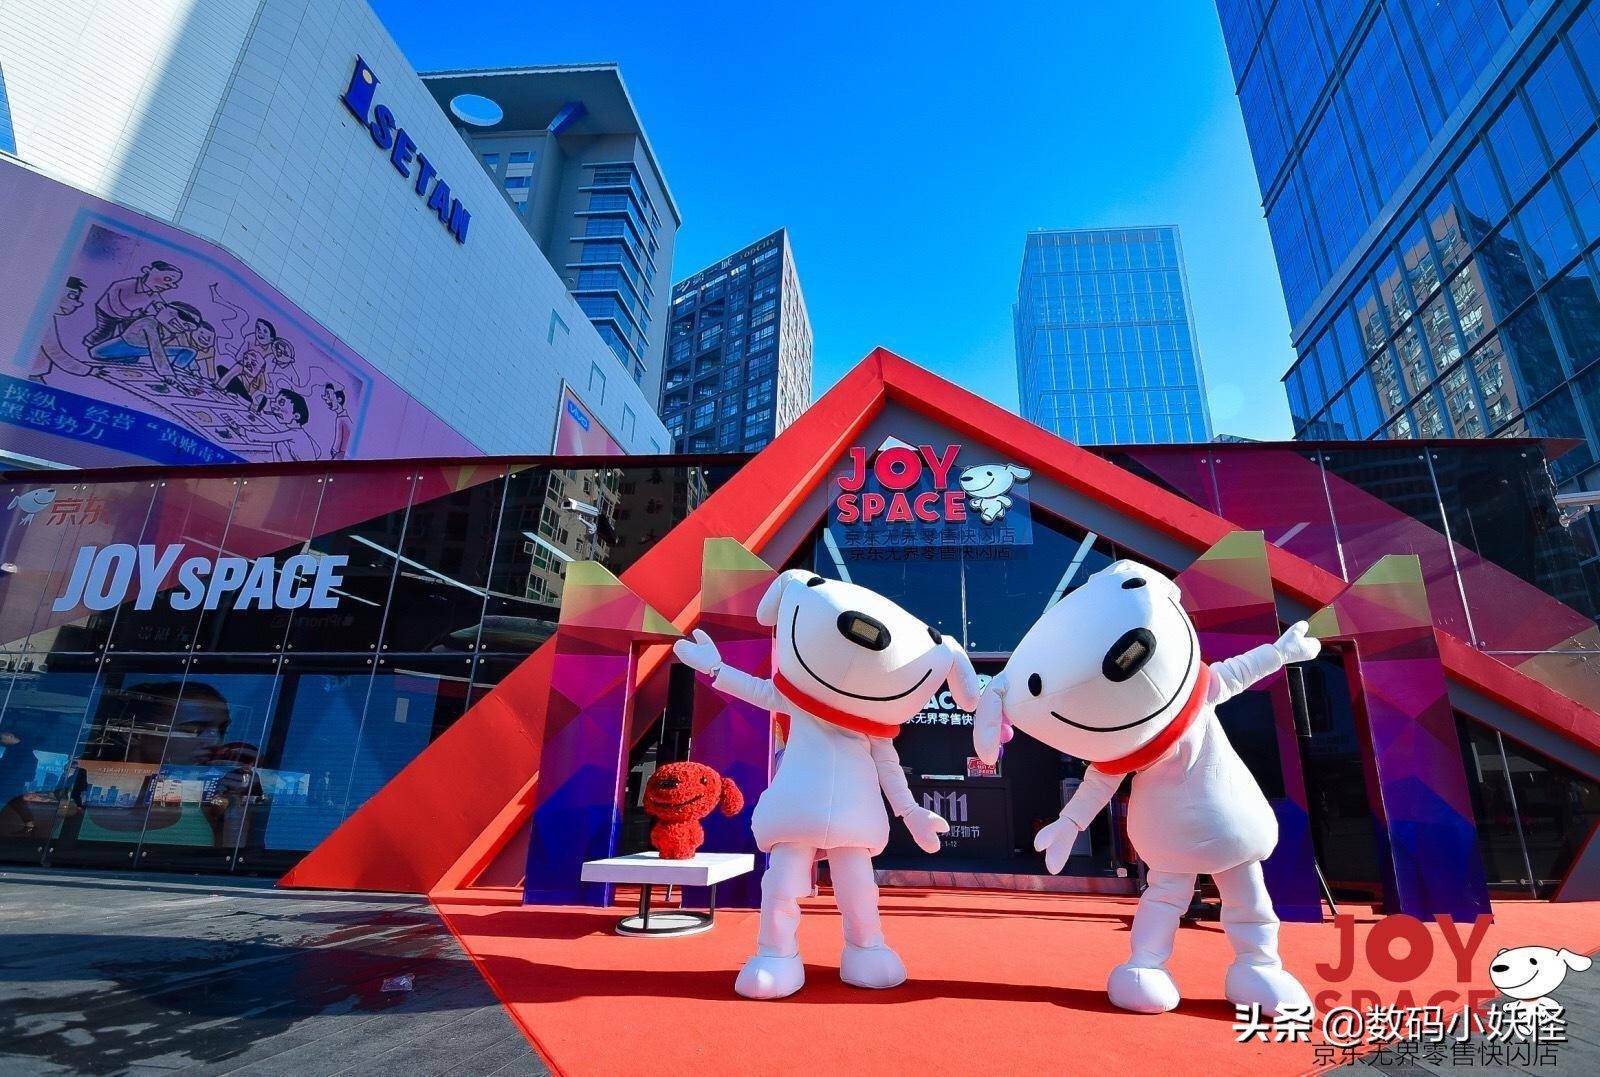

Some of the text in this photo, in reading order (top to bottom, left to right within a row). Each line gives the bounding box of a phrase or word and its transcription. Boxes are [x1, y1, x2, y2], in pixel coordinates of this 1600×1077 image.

[837, 444, 962, 492] JOY
[46, 496, 112, 526] 京东
[836, 490, 967, 524] SPACE
[844, 526, 1016, 545] 京东无界零售快闪店
